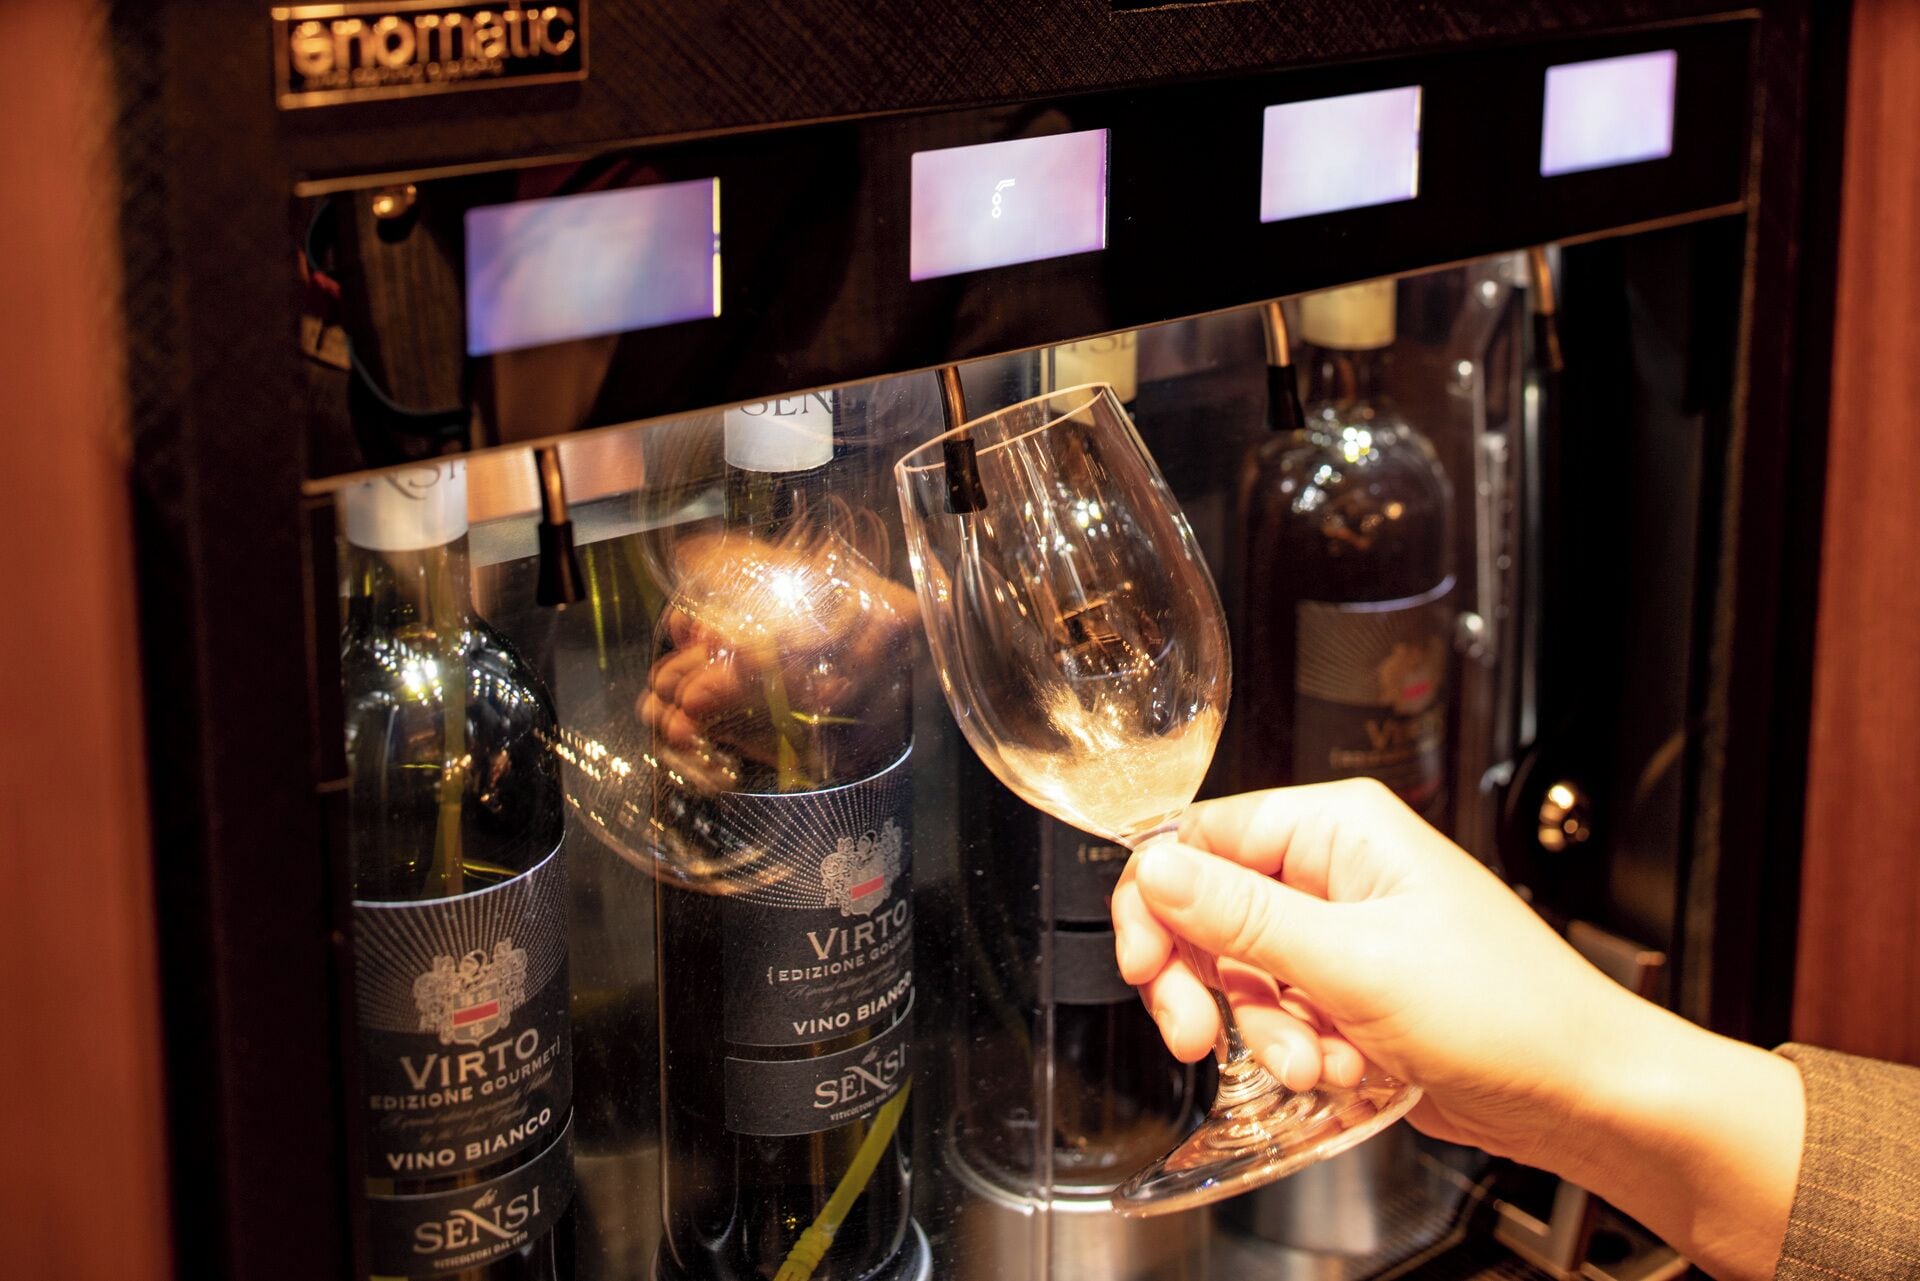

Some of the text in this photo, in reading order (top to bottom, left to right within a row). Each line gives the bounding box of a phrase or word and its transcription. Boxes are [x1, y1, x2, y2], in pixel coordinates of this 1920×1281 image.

[807, 899, 907, 961] VIRTO
[793, 970, 912, 1036] VINO BIANCO
[400, 1027, 540, 1091] VIRTO
[813, 1042, 906, 1109] SENSI
[370, 1086, 474, 1111] EDIZIONE
[386, 1106, 552, 1171] VINO BIANCO
[412, 1185, 541, 1255] SENSI
